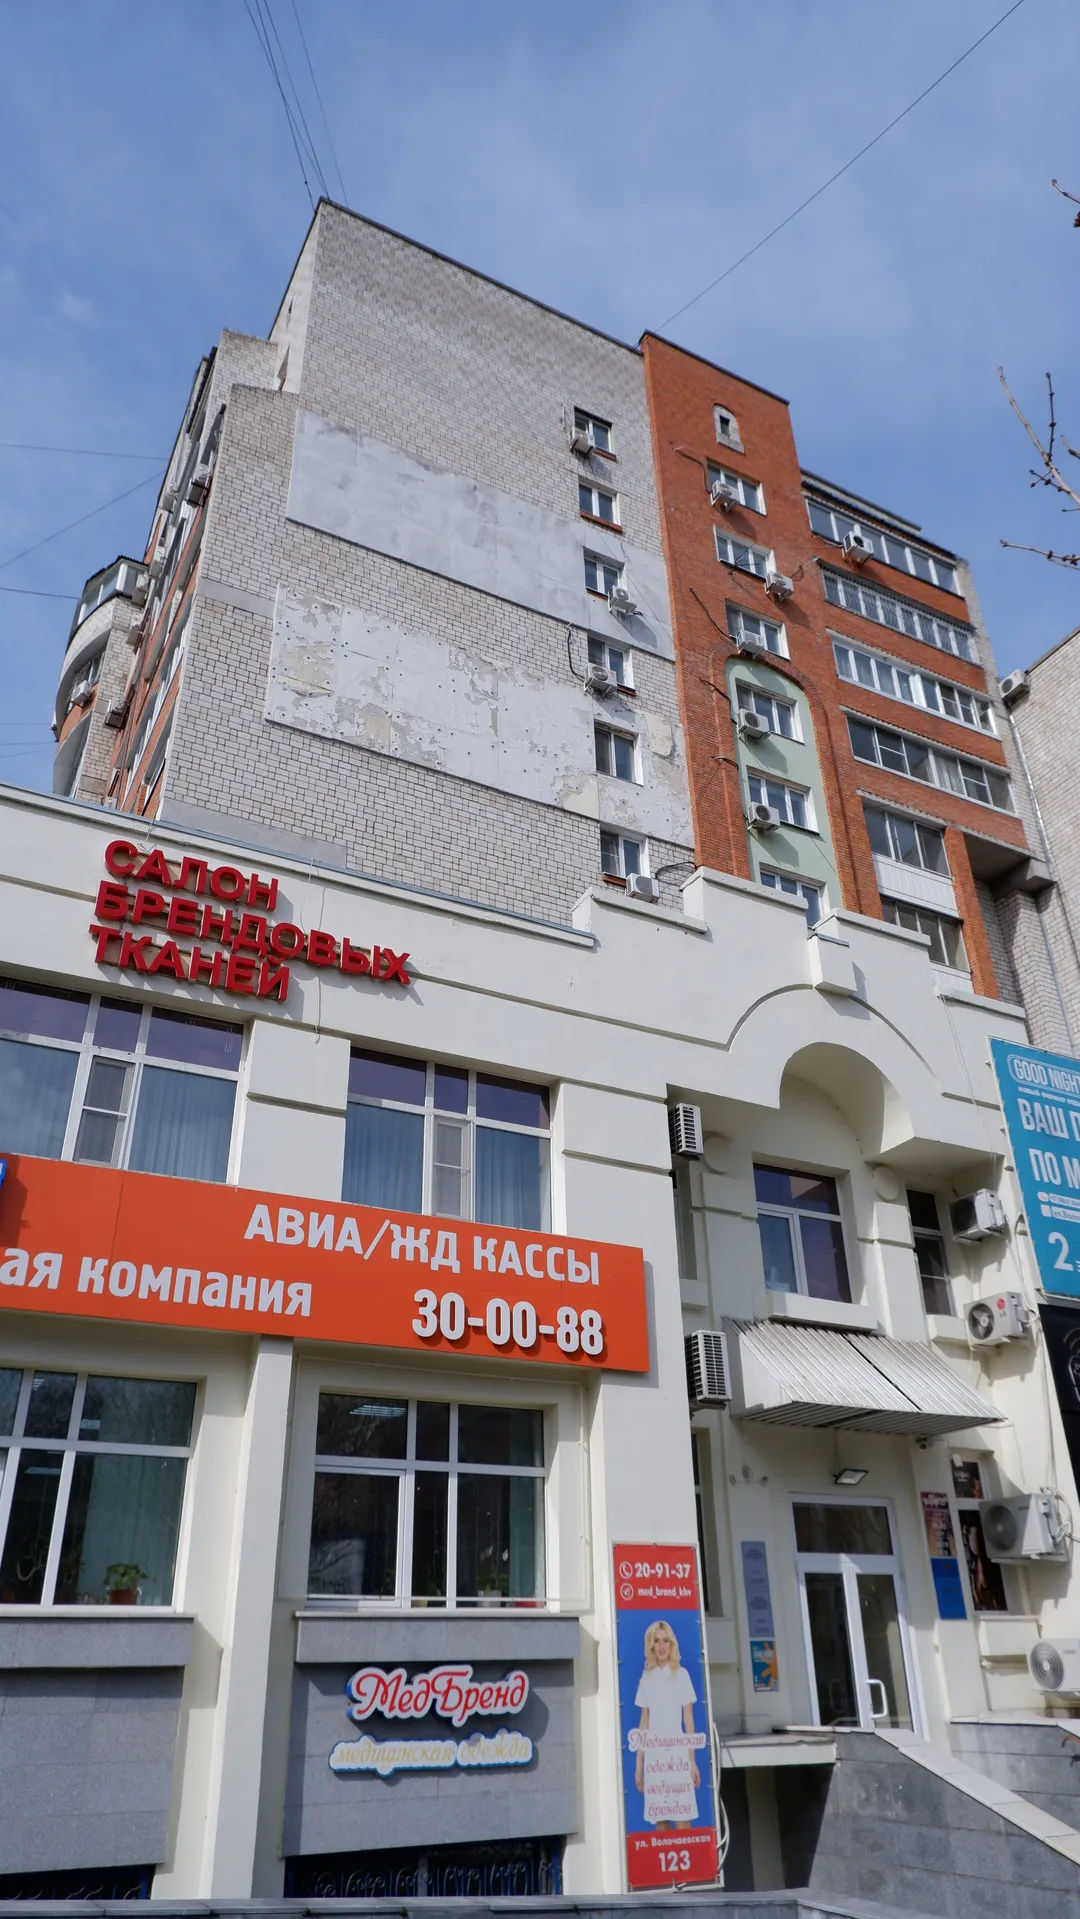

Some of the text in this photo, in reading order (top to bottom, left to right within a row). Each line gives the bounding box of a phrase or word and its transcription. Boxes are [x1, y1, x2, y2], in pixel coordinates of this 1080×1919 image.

[104, 840, 279, 912] САЛОН
[94, 880, 412, 985] БРЕНДОВЫХ
[89, 924, 291, 1003] ТКАНЕЙ
[1013, 1059, 1048, 1085] GOOD
[1017, 1098, 1070, 1140] ВАШ
[1028, 1148, 1062, 1186] ПО
[244, 1203, 600, 1286] АВИА/ЖД КАССЫ
[1048, 1231, 1074, 1271] 2
[0, 1247, 313, 1318] ая компания
[411, 1288, 604, 1356] 30-00-88
[635, 1562, 691, 1579] 20-91-37
[638, 1585, 692, 1599] med_brand_khv
[355, 1669, 526, 1722] МедБренд
[337, 1732, 529, 1766] медицинская одежда
[630, 1732, 705, 1751] Медицинская
[647, 1756, 689, 1773] одежда
[647, 1780, 692, 1798] ведущих
[648, 1801, 692, 1819] брендов
[635, 1836, 711, 1850] ул. Волочаевская
[658, 1850, 691, 1872] 123
